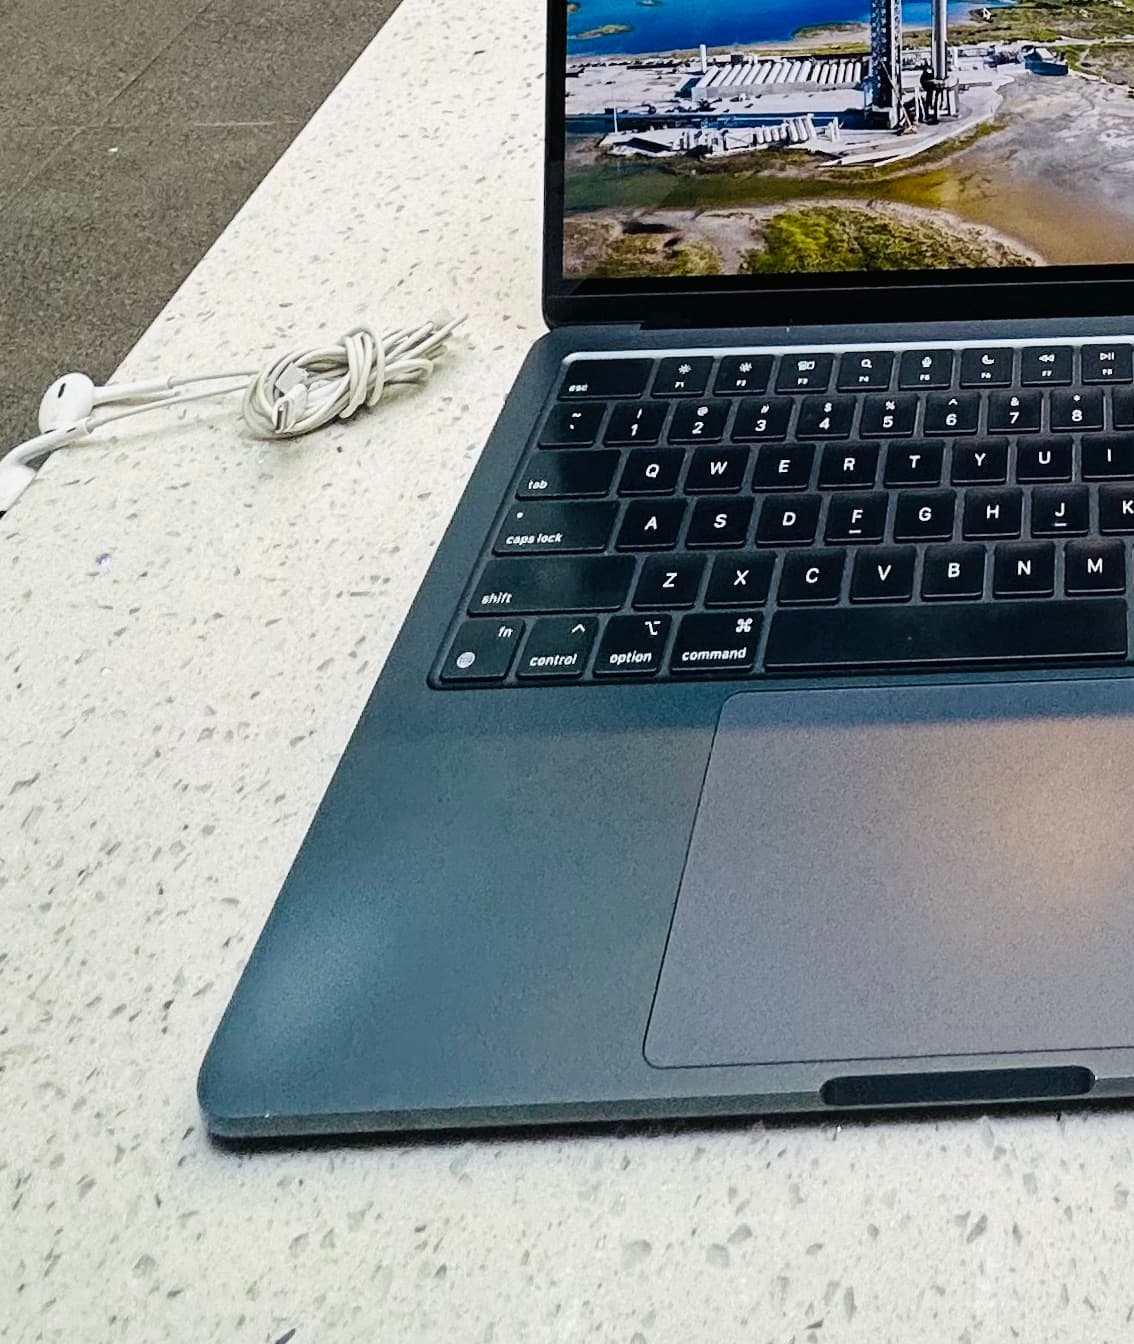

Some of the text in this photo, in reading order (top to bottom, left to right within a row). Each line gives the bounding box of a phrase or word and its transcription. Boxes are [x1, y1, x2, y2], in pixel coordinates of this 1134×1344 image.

[631, 423, 639, 437] 1
[691, 421, 705, 435] 2
[754, 419, 767, 432] 3
[818, 417, 830, 430] 4
[882, 415, 894, 429] 5
[945, 413, 957, 426] 6
[1009, 411, 1020, 424] 7
[1071, 409, 1083, 422] 8
[528, 479, 548, 490] tab
[645, 463, 660, 478] Q
[710, 460, 728, 475] W
[778, 459, 791, 473] E
[843, 457, 856, 471] R
[909, 454, 921, 469] T
[974, 452, 987, 467] Y
[1038, 450, 1051, 465] U
[505, 535, 535, 546] caps
[536, 532, 563, 544] lock
[643, 515, 658, 531] A
[713, 513, 728, 529] S
[782, 511, 797, 527] D
[851, 509, 864, 524] F
[918, 506, 932, 522] G
[986, 504, 1000, 519] H
[1054, 502, 1065, 517] J
[1122, 499, 1134, 515] K
[481, 557, 1103, 605] shift Z X C V B N M
[497, 625, 514, 638] fn
[529, 653, 578, 667] control
[609, 650, 653, 666] option
[681, 646, 747, 663] command
